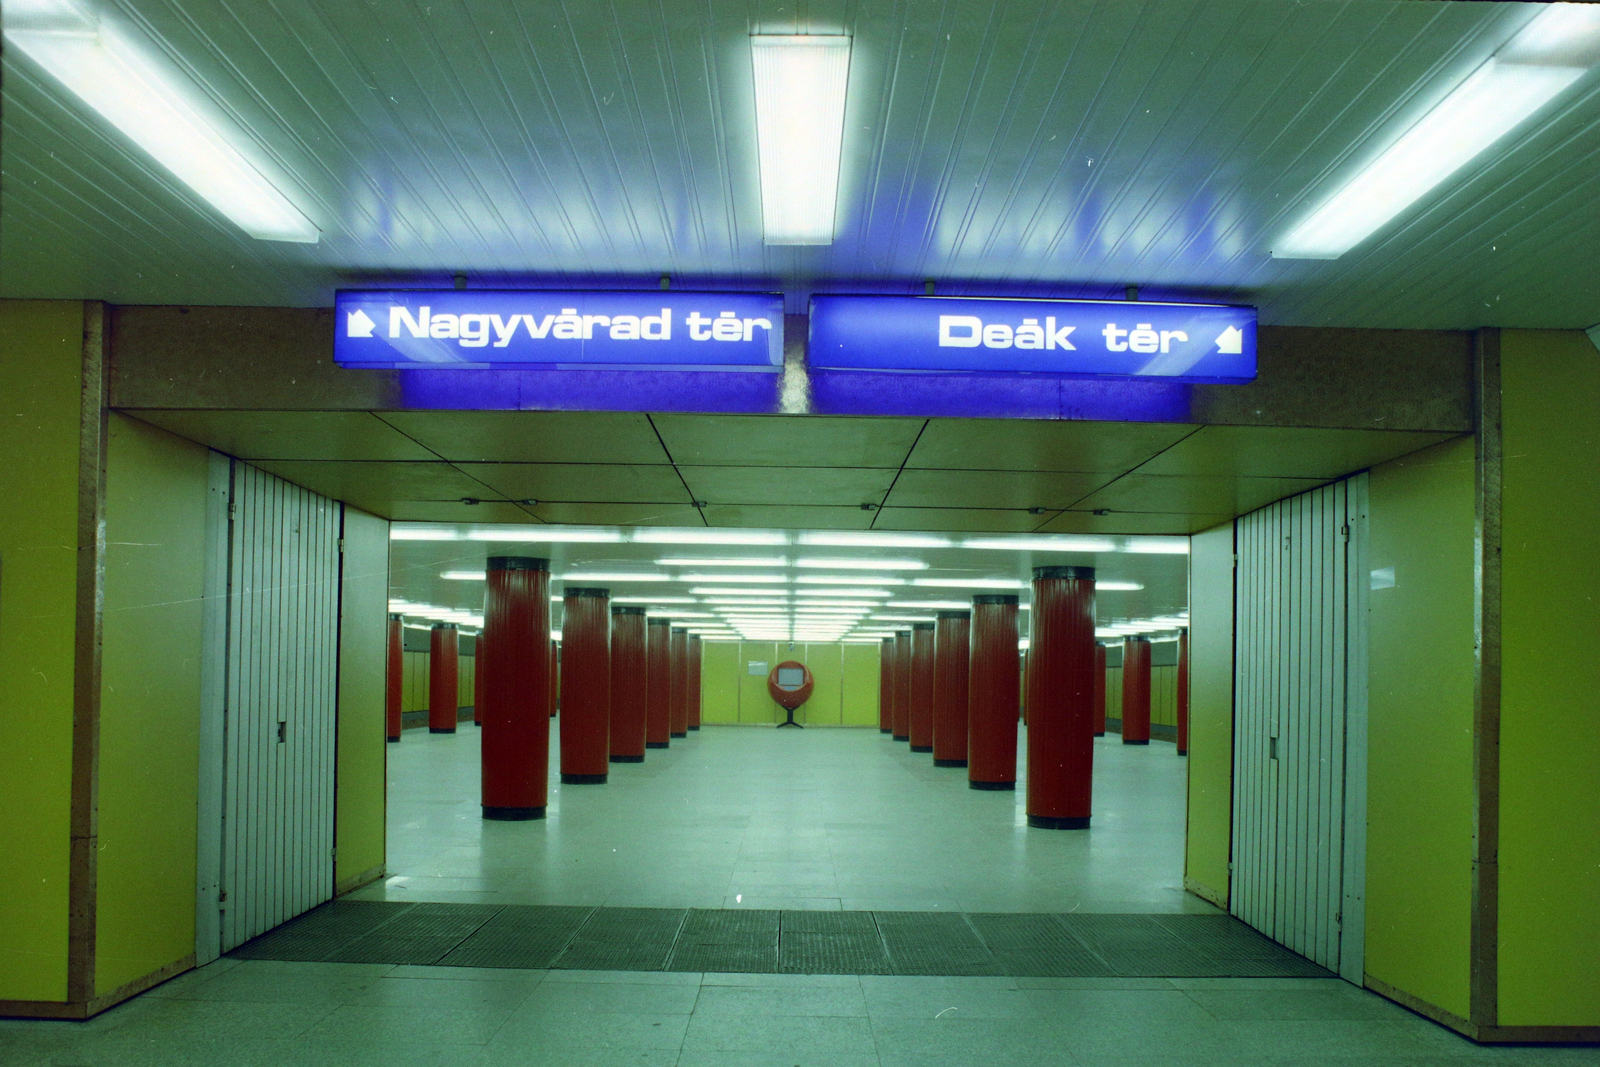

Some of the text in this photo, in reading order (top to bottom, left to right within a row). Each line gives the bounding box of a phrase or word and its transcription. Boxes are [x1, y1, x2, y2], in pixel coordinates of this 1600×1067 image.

[389, 306, 772, 348] Nagyvárad tér
[939, 315, 1188, 354] Deák tér
